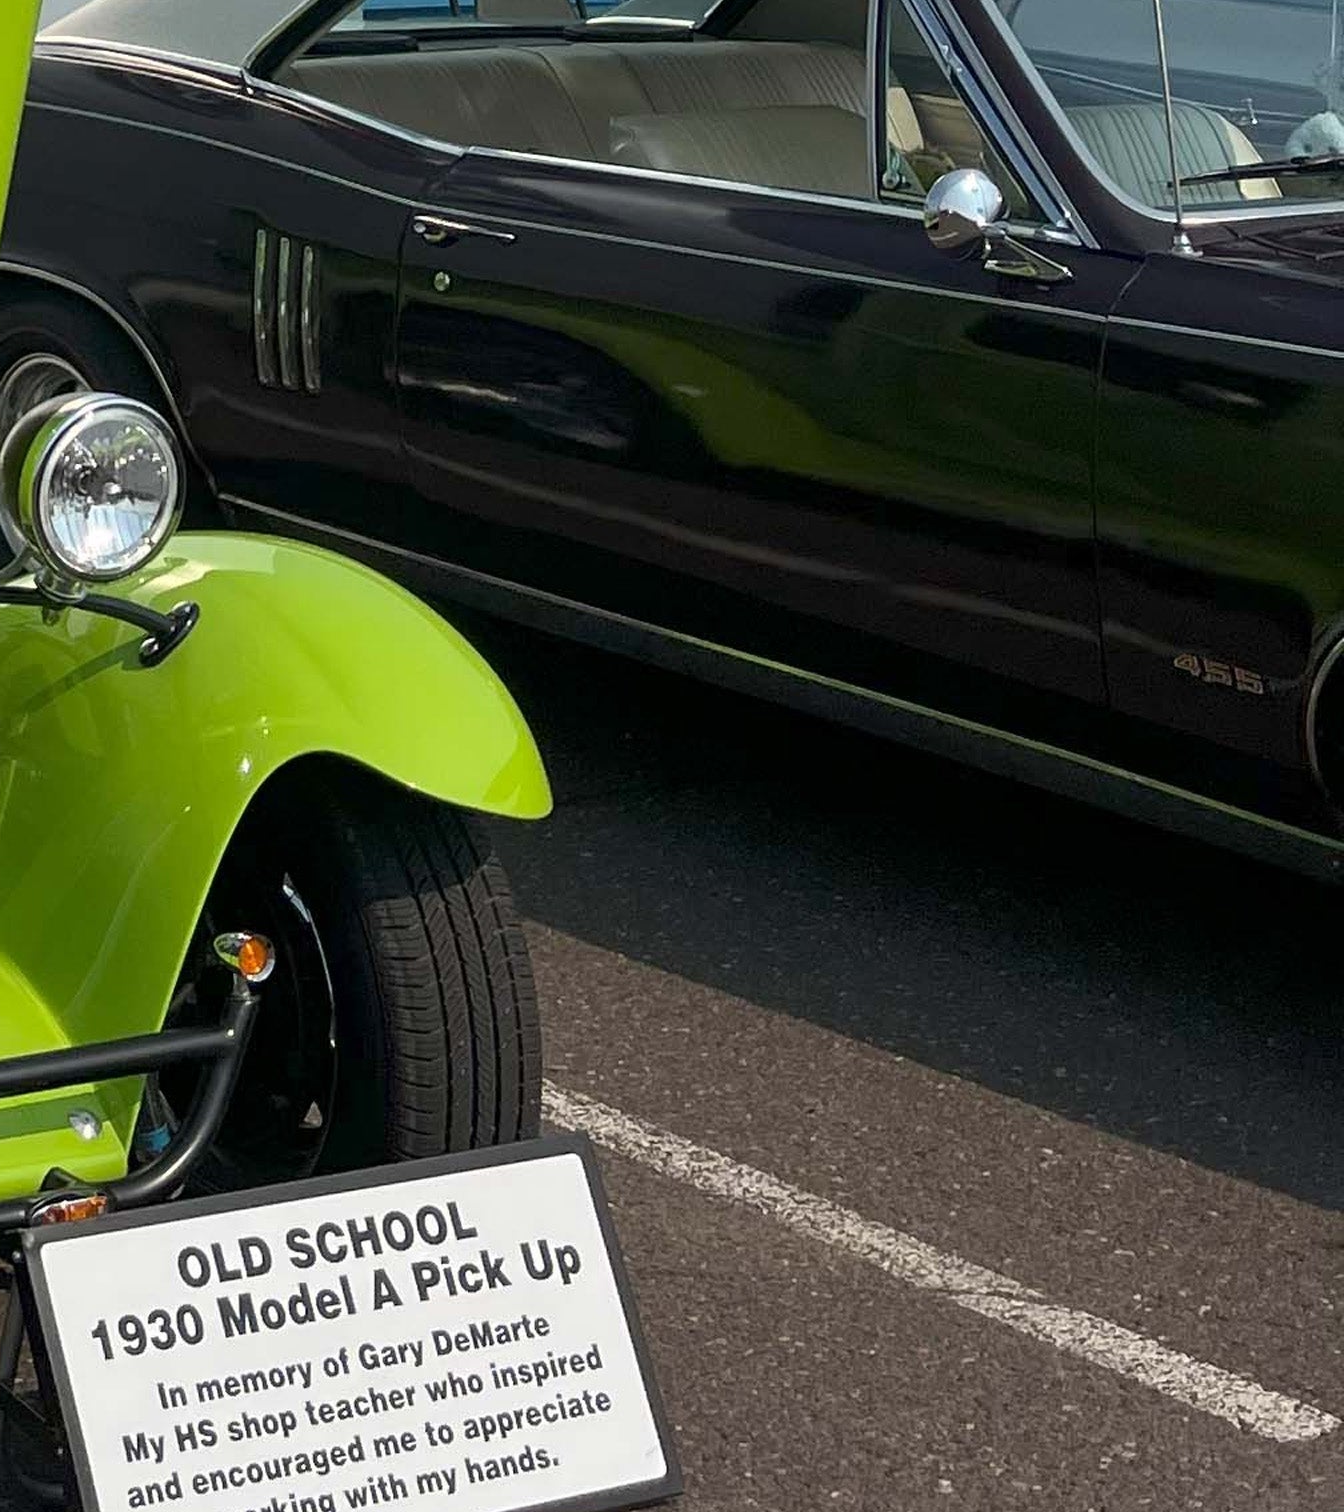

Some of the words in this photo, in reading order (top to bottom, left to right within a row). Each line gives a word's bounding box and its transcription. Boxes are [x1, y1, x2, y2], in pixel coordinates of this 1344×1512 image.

[1174, 654, 1263, 695] 455
[178, 1238, 272, 1288] OLD
[286, 1202, 478, 1269] SCHOOL
[91, 1304, 204, 1360] 1930
[217, 1275, 357, 1338] Model
[373, 1268, 403, 1311] A
[412, 1250, 512, 1301] Pick
[520, 1239, 581, 1285] Up
[122, 1432, 164, 1463] My
[174, 1419, 218, 1453] HS
[227, 1410, 297, 1441] shop
[305, 1387, 415, 1426] teacher
[424, 1372, 484, 1402] who
[491, 1344, 603, 1388] inspired
[157, 1382, 188, 1409] In
[197, 1361, 312, 1403] memory
[323, 1347, 350, 1378] of
[358, 1341, 423, 1371] Gary
[432, 1314, 550, 1356] DeMarte
[127, 1472, 183, 1508] and
[192, 1435, 366, 1495] encouraged
[373, 1431, 417, 1458] me
[424, 1422, 454, 1447] to
[463, 1390, 611, 1442] appreciate
[344, 1473, 409, 1509] with
[416, 1468, 456, 1495] my
[464, 1445, 560, 1484] hands.
